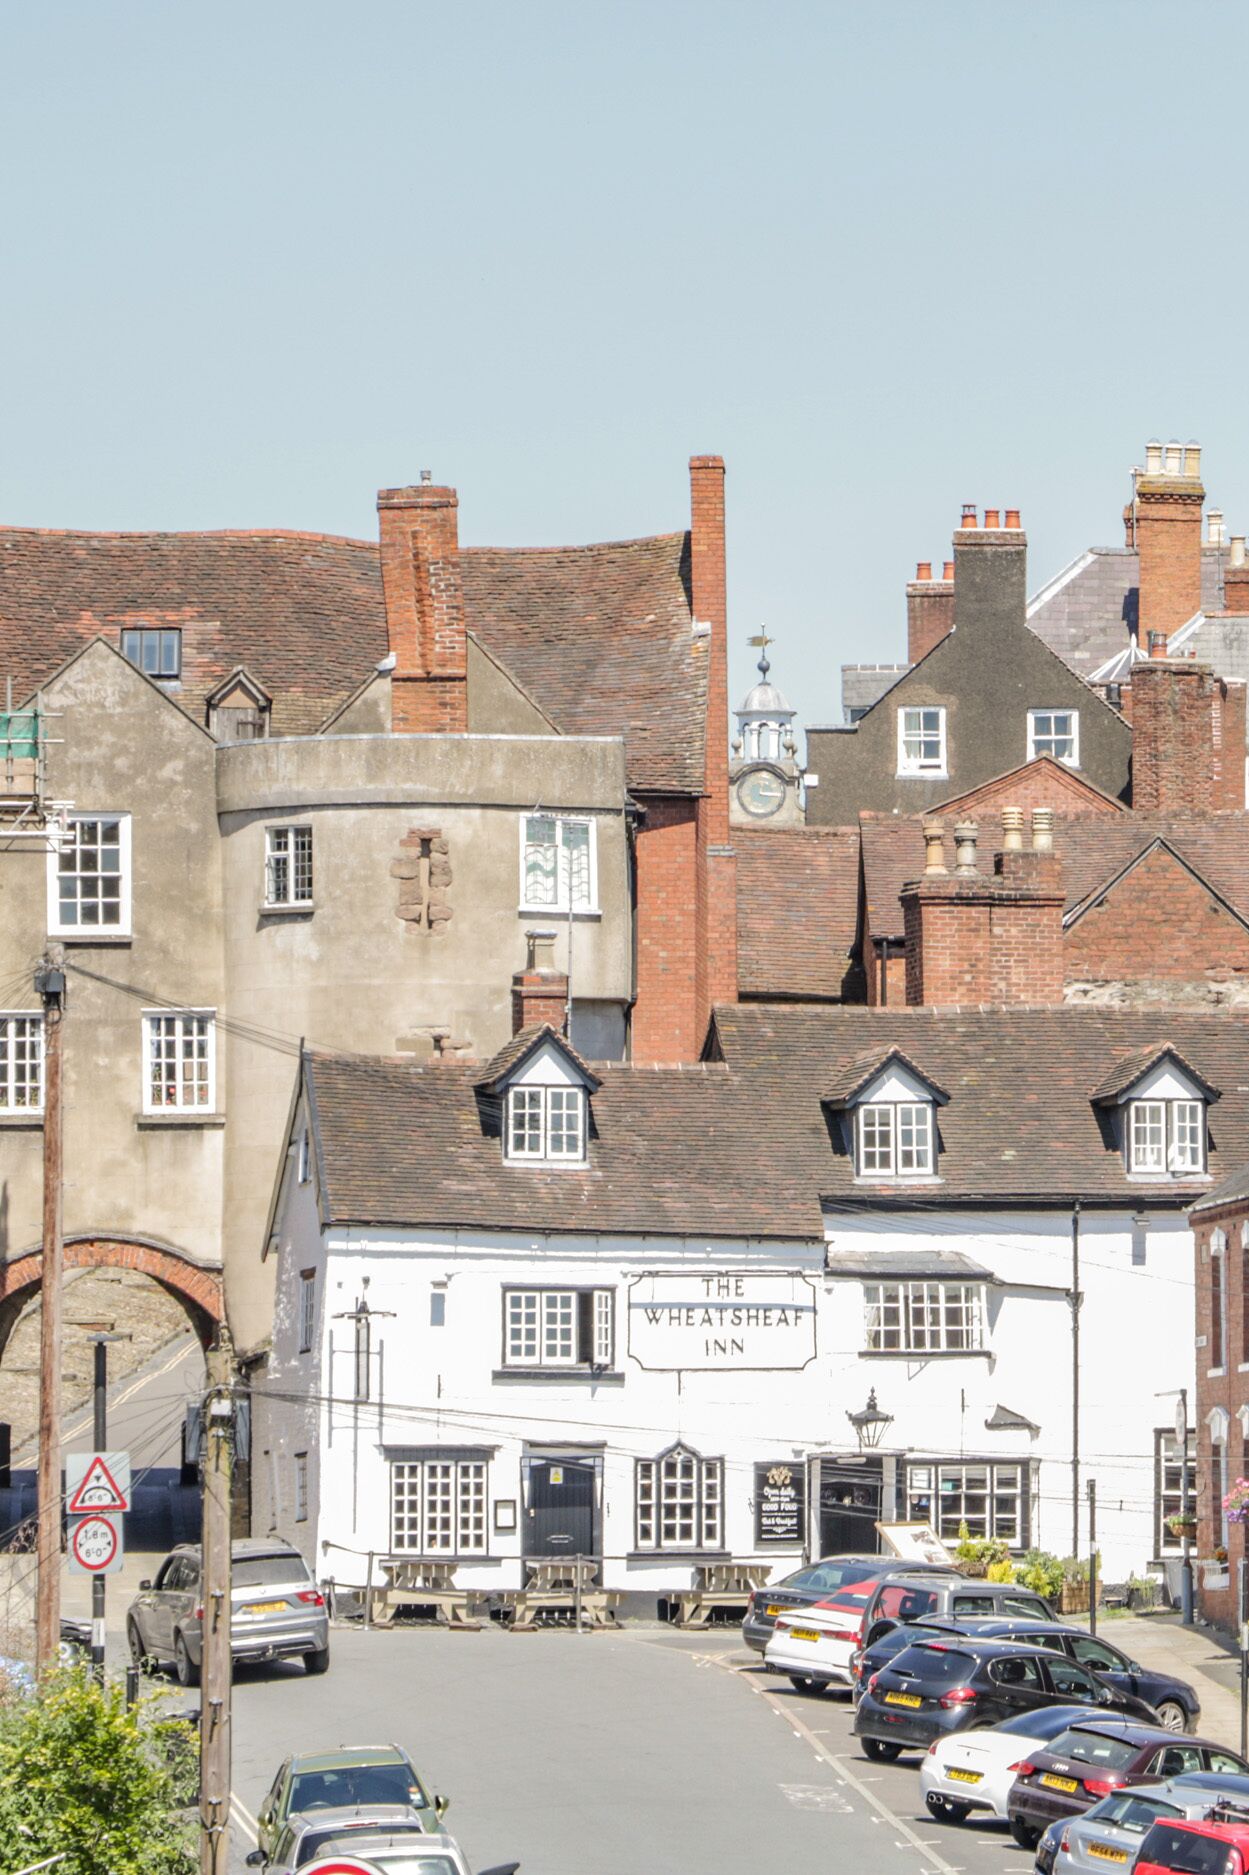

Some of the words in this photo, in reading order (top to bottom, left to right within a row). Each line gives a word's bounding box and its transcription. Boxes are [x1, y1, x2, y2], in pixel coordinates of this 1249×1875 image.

[701, 1278, 745, 1297] THE
[644, 1307, 804, 1327] WHEATSHEAF
[705, 1338, 744, 1357] INN
